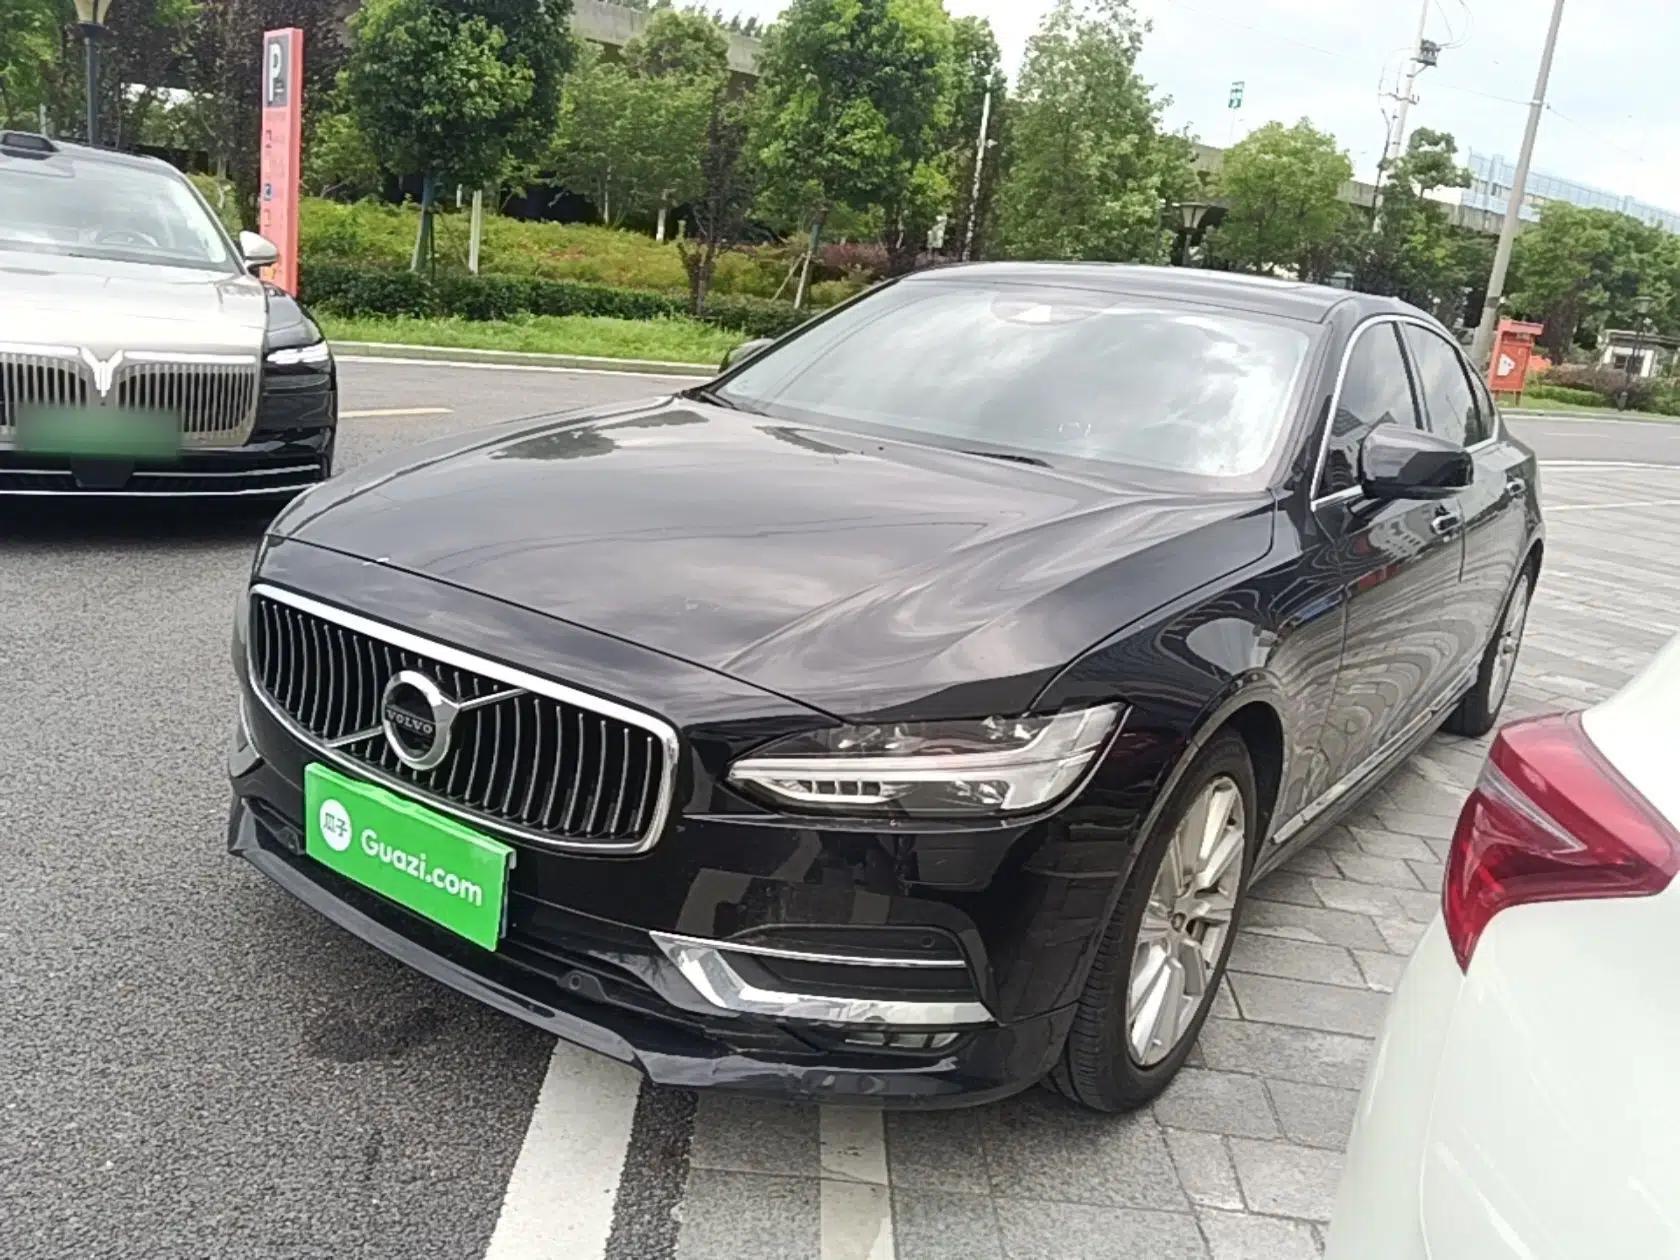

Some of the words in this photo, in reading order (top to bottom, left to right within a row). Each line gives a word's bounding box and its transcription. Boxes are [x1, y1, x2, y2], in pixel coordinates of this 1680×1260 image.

[269, 43, 282, 101] P
[386, 709, 433, 734] VOLVO
[324, 812, 348, 837] 瓜子
[361, 829, 482, 906] Guazi.com
